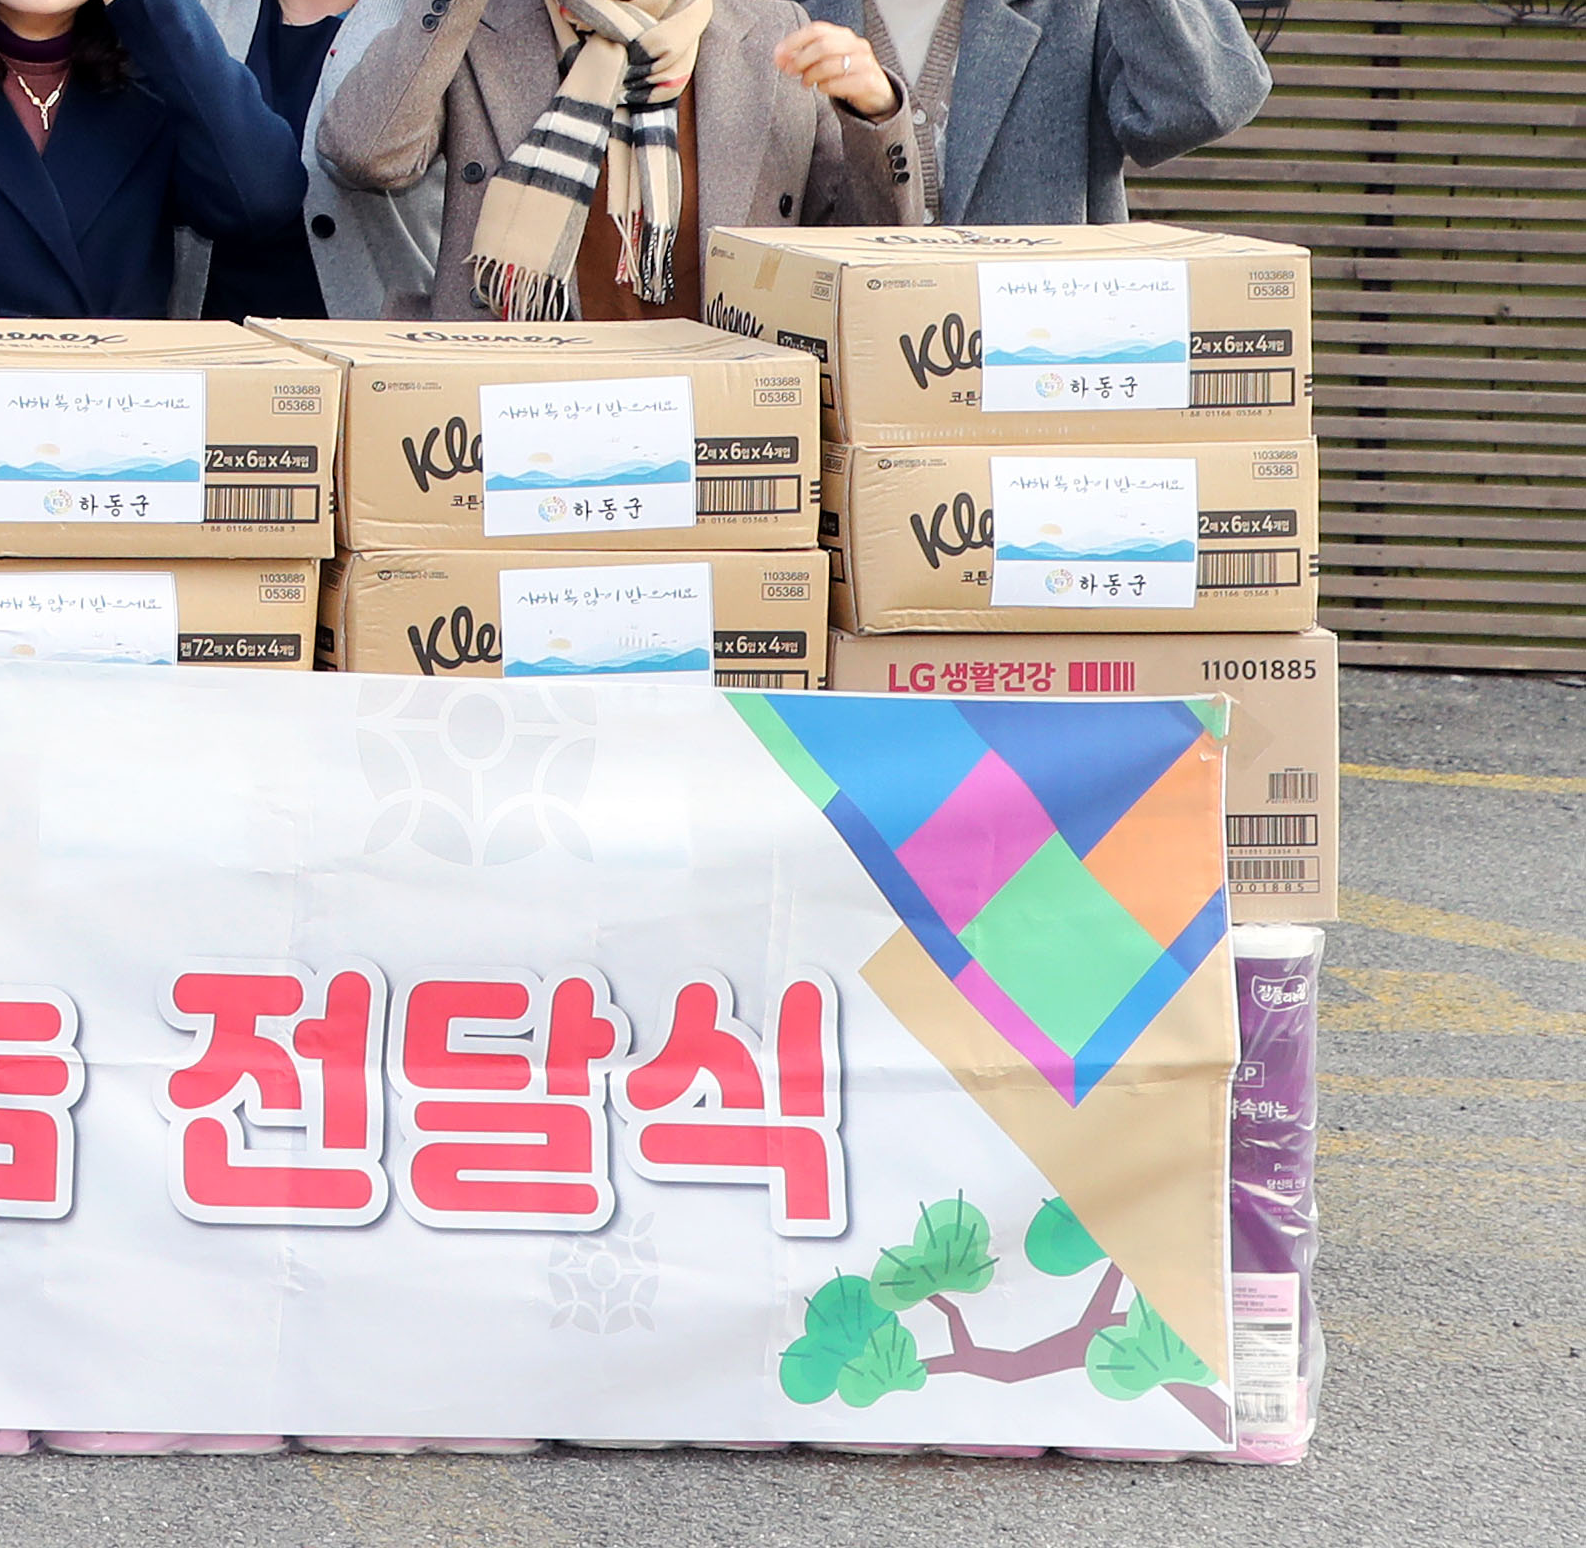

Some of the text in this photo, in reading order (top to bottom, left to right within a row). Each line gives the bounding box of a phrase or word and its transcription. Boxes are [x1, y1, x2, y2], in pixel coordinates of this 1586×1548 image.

[1249, 270, 1295, 281] 11033689
[996, 279, 1038, 296] 새해
[1043, 279, 1058, 296] 복
[1102, 277, 1176, 296] 받으세요
[1253, 285, 1290, 296] 05368
[385, 331, 594, 345] Kleenex
[274, 385, 321, 395] 11033689
[754, 377, 801, 388] 11033689
[1069, 375, 1139, 399] 하동군
[7, 395, 50, 410] 새해
[54, 393, 70, 413] 복
[117, 393, 191, 413] 받으세요
[278, 399, 316, 411] 05368
[759, 391, 796, 403] 05368
[498, 402, 539, 420] 새해
[543, 401, 558, 421] 복
[604, 398, 679, 418] 받으세요
[1252, 450, 1298, 460] 11033689
[1257, 465, 1293, 476] 05368
[1009, 476, 1050, 491] 새해
[1054, 475, 1069, 492] 복
[1113, 474, 1186, 494] 받으세요
[78, 493, 150, 518] 하동군
[572, 497, 644, 523] 하동군
[259, 573, 306, 584] 11033689
[762, 571, 810, 581] 11033689
[1079, 573, 1148, 597] 하동군
[265, 588, 301, 600] 05368
[516, 590, 559, 606] 새해
[563, 588, 579, 608] 복
[625, 585, 699, 605] 받으세요
[767, 586, 805, 598] 05368
[28, 595, 43, 612] 복
[89, 595, 163, 613] 받으세요
[407, 605, 503, 676] Kle
[888, 660, 1057, 693] LG 생활건강
[1200, 659, 1317, 681] 11001885
[164, 964, 838, 1224] 전달식
